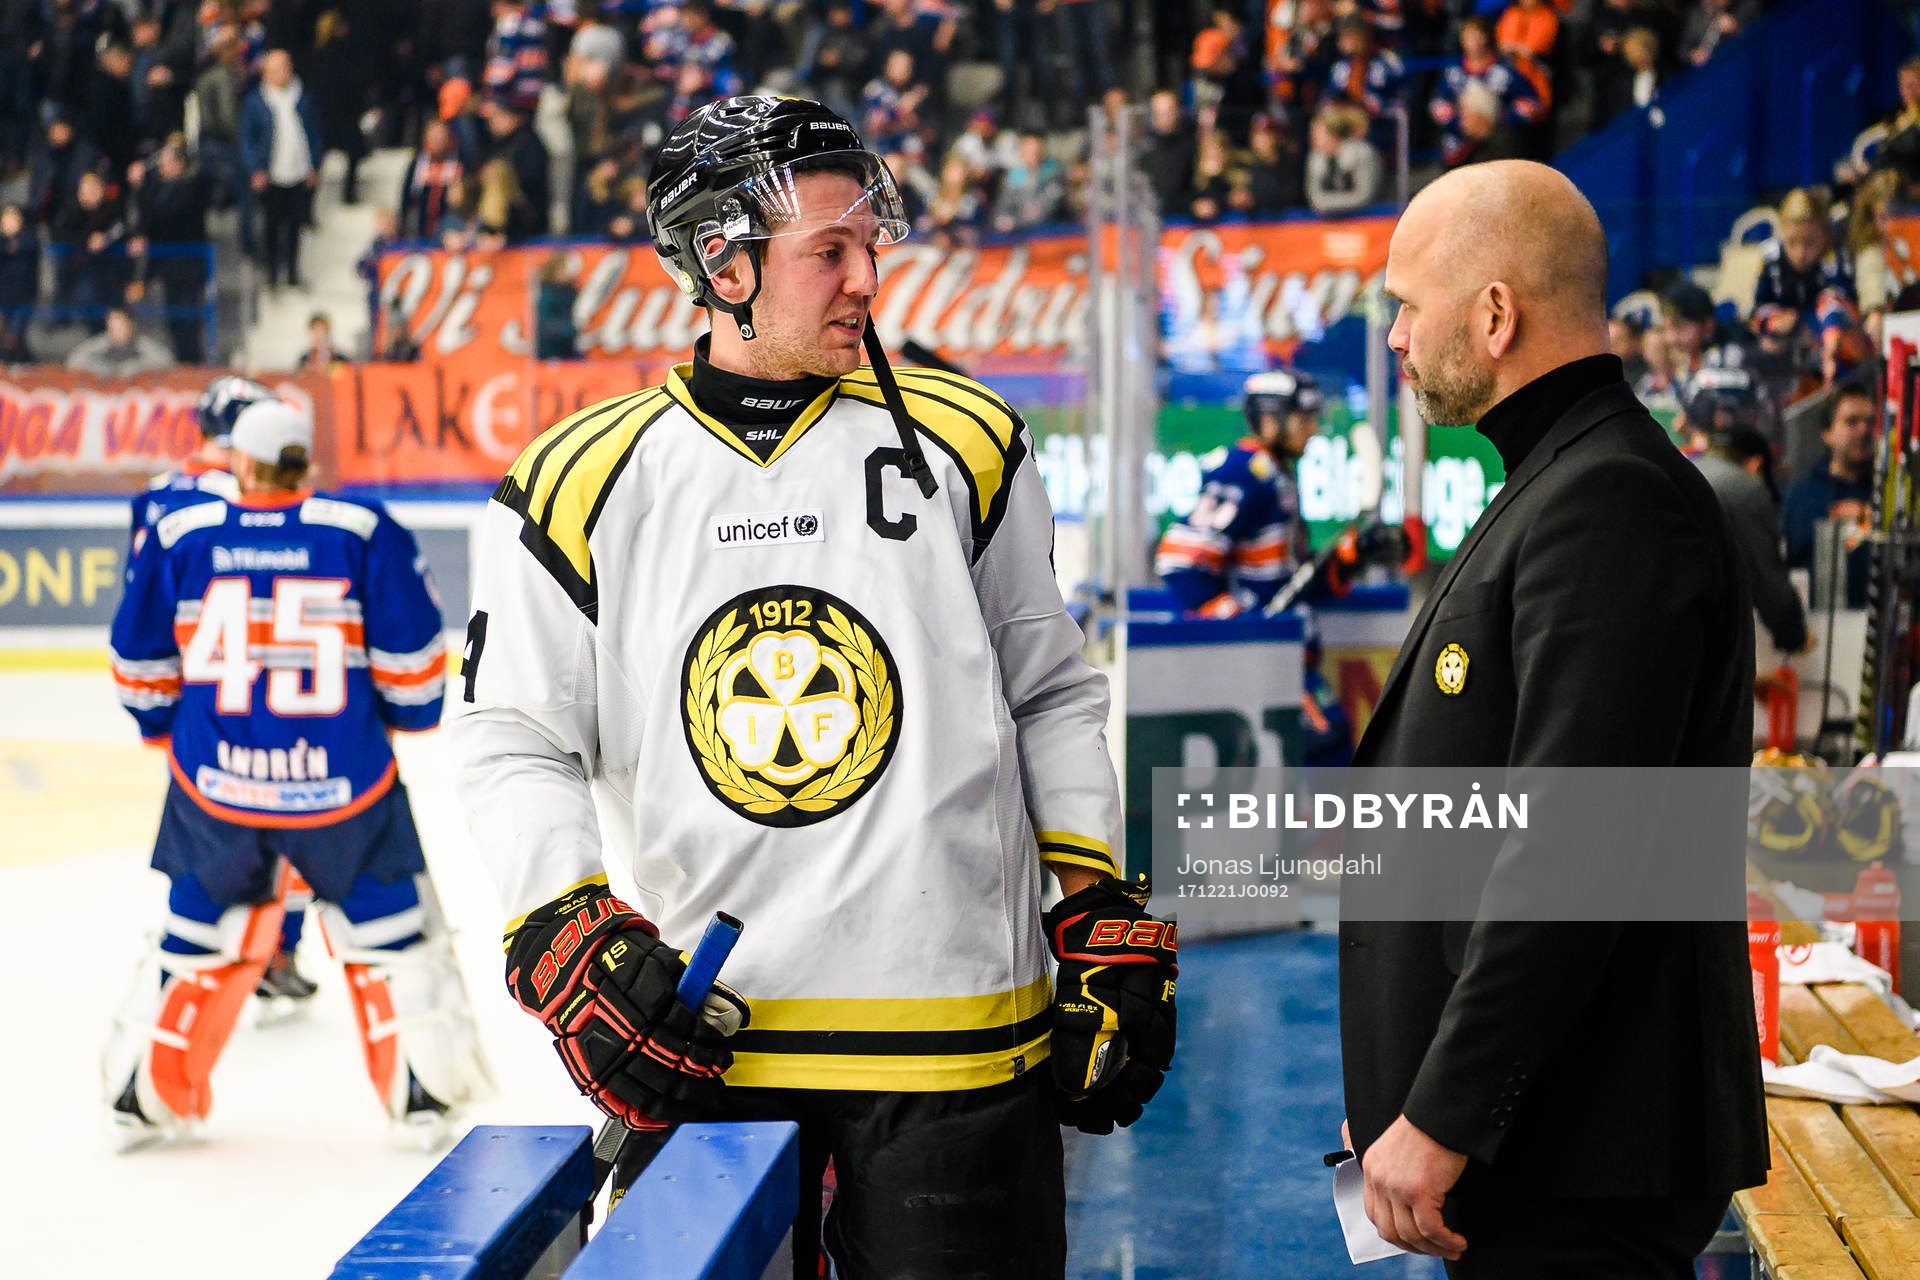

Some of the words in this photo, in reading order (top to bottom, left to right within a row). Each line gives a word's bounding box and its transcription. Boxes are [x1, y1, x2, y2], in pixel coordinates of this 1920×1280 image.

[659, 171, 698, 210] BAUER
[745, 428, 783, 441] SHL
[864, 446, 918, 542] C
[717, 516, 789, 543] unicef
[748, 599, 814, 630] 1912
[182, 576, 352, 719] 45
[773, 651, 796, 681] B
[747, 715, 757, 745] I
[812, 711, 833, 743] F
[601, 939, 628, 972] 1S
